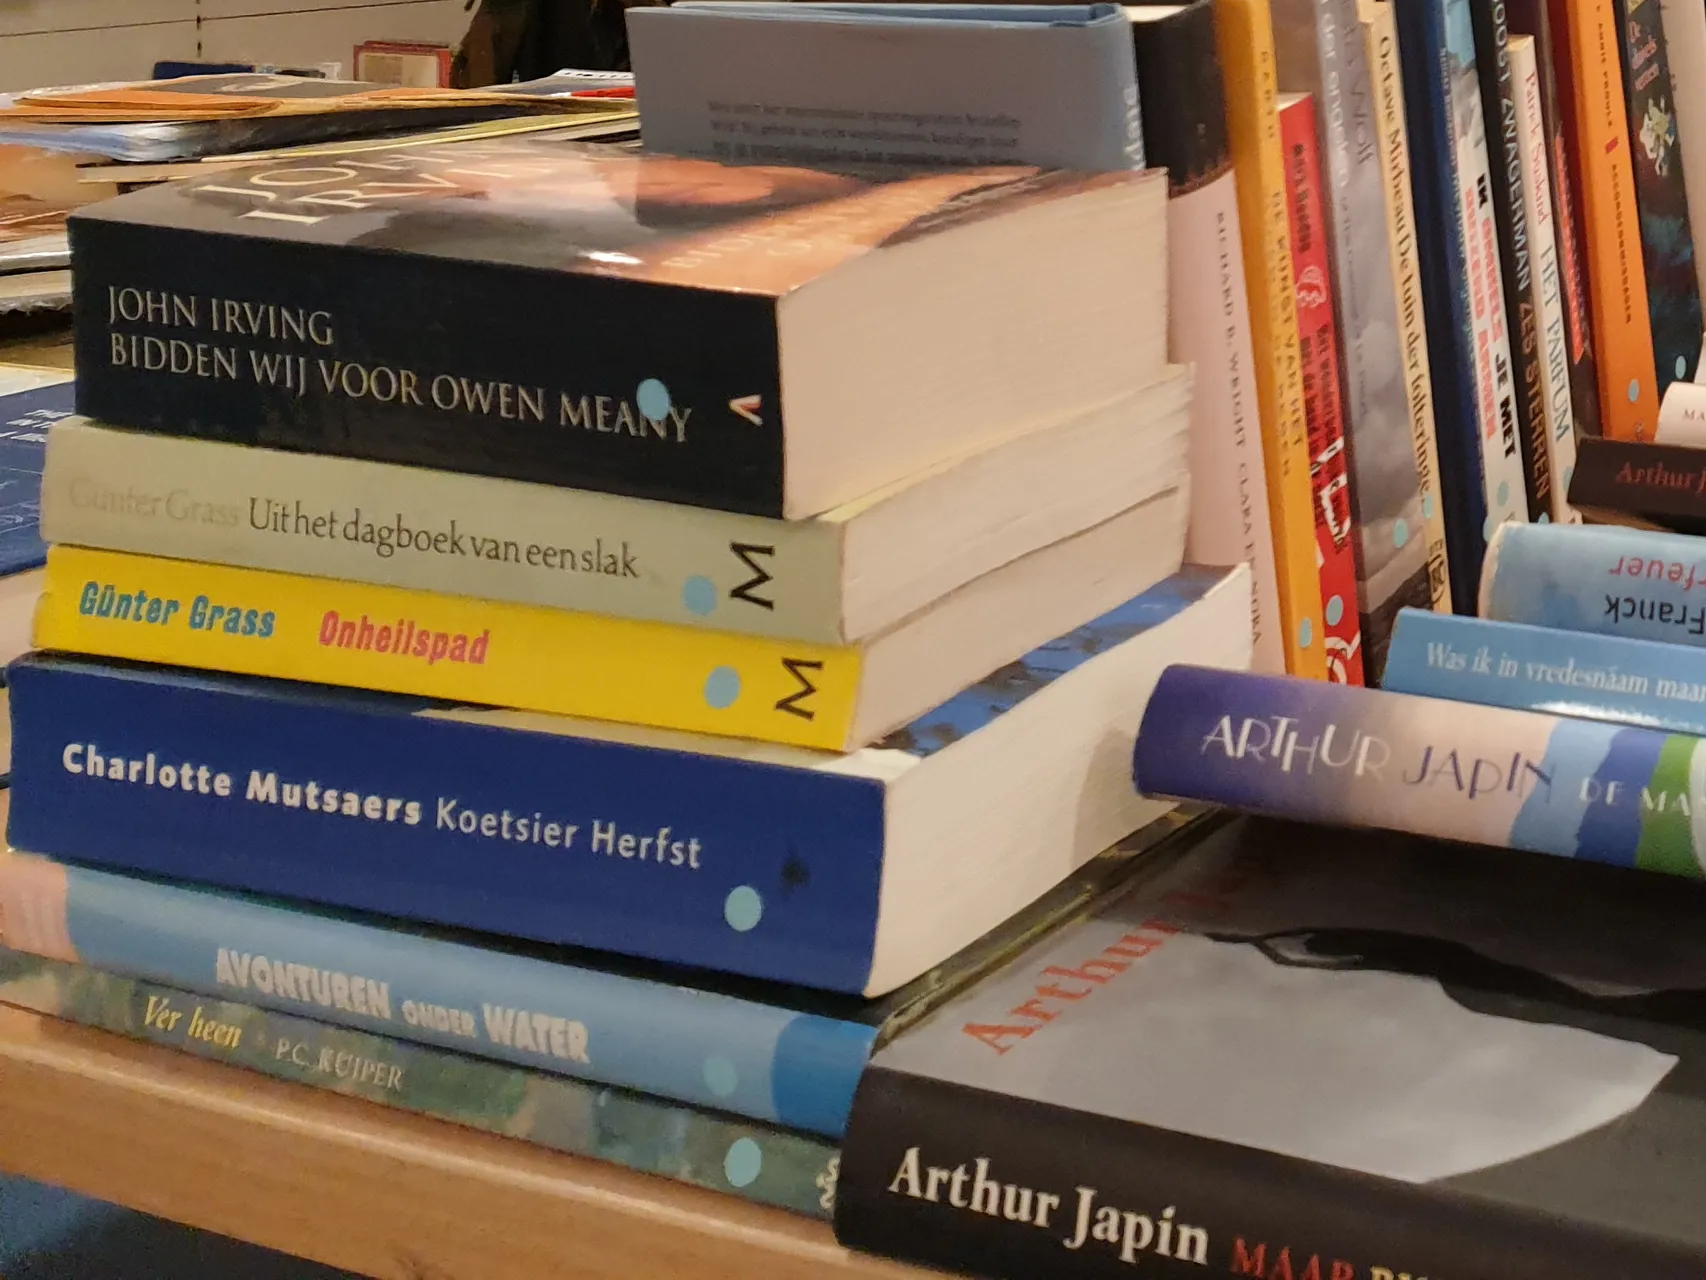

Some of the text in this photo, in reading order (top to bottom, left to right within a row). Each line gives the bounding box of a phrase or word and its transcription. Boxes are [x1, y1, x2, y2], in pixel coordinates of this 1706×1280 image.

[1379, 35, 1397, 123] Octave
[1386, 128, 1409, 236] Mirbeau
[108, 284, 335, 347] JOHN IRVING
[1477, 172, 1518, 459] IK JE MET
[1501, 97, 1531, 293] ZWAGERMAN
[1526, 360, 1551, 501] STERREN
[1540, 245, 1559, 308] HET
[109, 332, 547, 422] BIDDEN WIJ VOOR OWEN
[1406, 330, 1420, 370] der
[1547, 320, 1571, 442] PARFUM
[1229, 351, 1248, 449] WRIGHT
[1239, 461, 1253, 537] CLARA
[1615, 460, 1694, 488] Arthur
[248, 495, 641, 580] Uit het dagboek van een slak
[79, 579, 491, 666] Günter Grass Onheilspad
[1426, 641, 1468, 672] Was
[1471, 643, 1493, 676] ik
[1498, 648, 1519, 678] in
[1603, 593, 1706, 634] Franck
[1201, 714, 1392, 781] ARTHUR
[1402, 745, 1558, 806] JAPIN
[62, 742, 702, 871] Charlotte Mutsaers Koetsier Herfst
[215, 946, 592, 1065] AVONTUREN ONDER WATER
[962, 917, 1187, 1056] Arthur
[143, 993, 182, 1033] Ver
[187, 1005, 243, 1049] heen
[313, 1046, 404, 1091] KUIPER
[888, 1147, 1211, 1266] Arthur Japin
